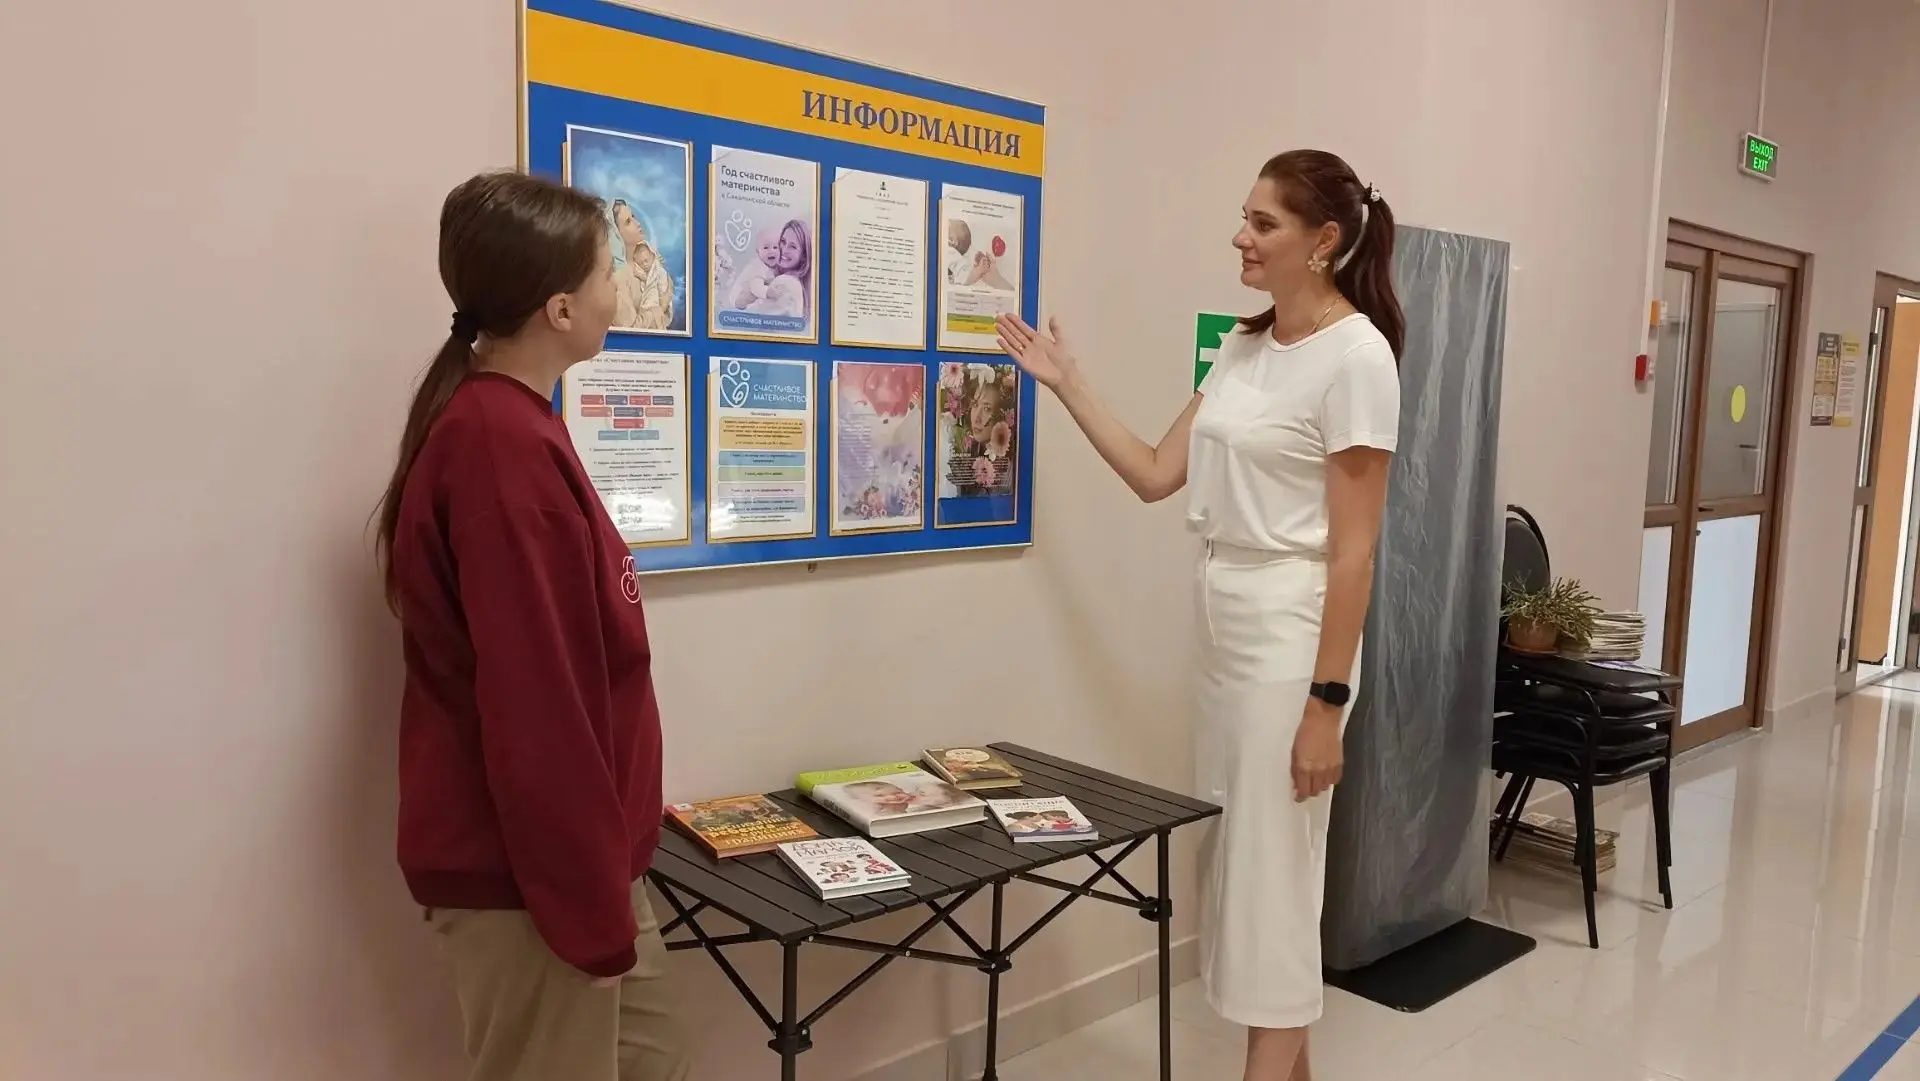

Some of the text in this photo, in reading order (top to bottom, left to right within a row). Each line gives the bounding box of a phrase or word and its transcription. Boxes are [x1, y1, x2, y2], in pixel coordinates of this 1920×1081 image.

[802, 90, 1022, 159] ИНФОРМАЦИЯ
[1750, 139, 1774, 161] ВЫХОД
[1753, 156, 1769, 172] EXIT
[721, 165, 795, 188] Год счастливого
[721, 180, 781, 197] материнства
[753, 383, 801, 394] СЧАСТЛИВОЕ
